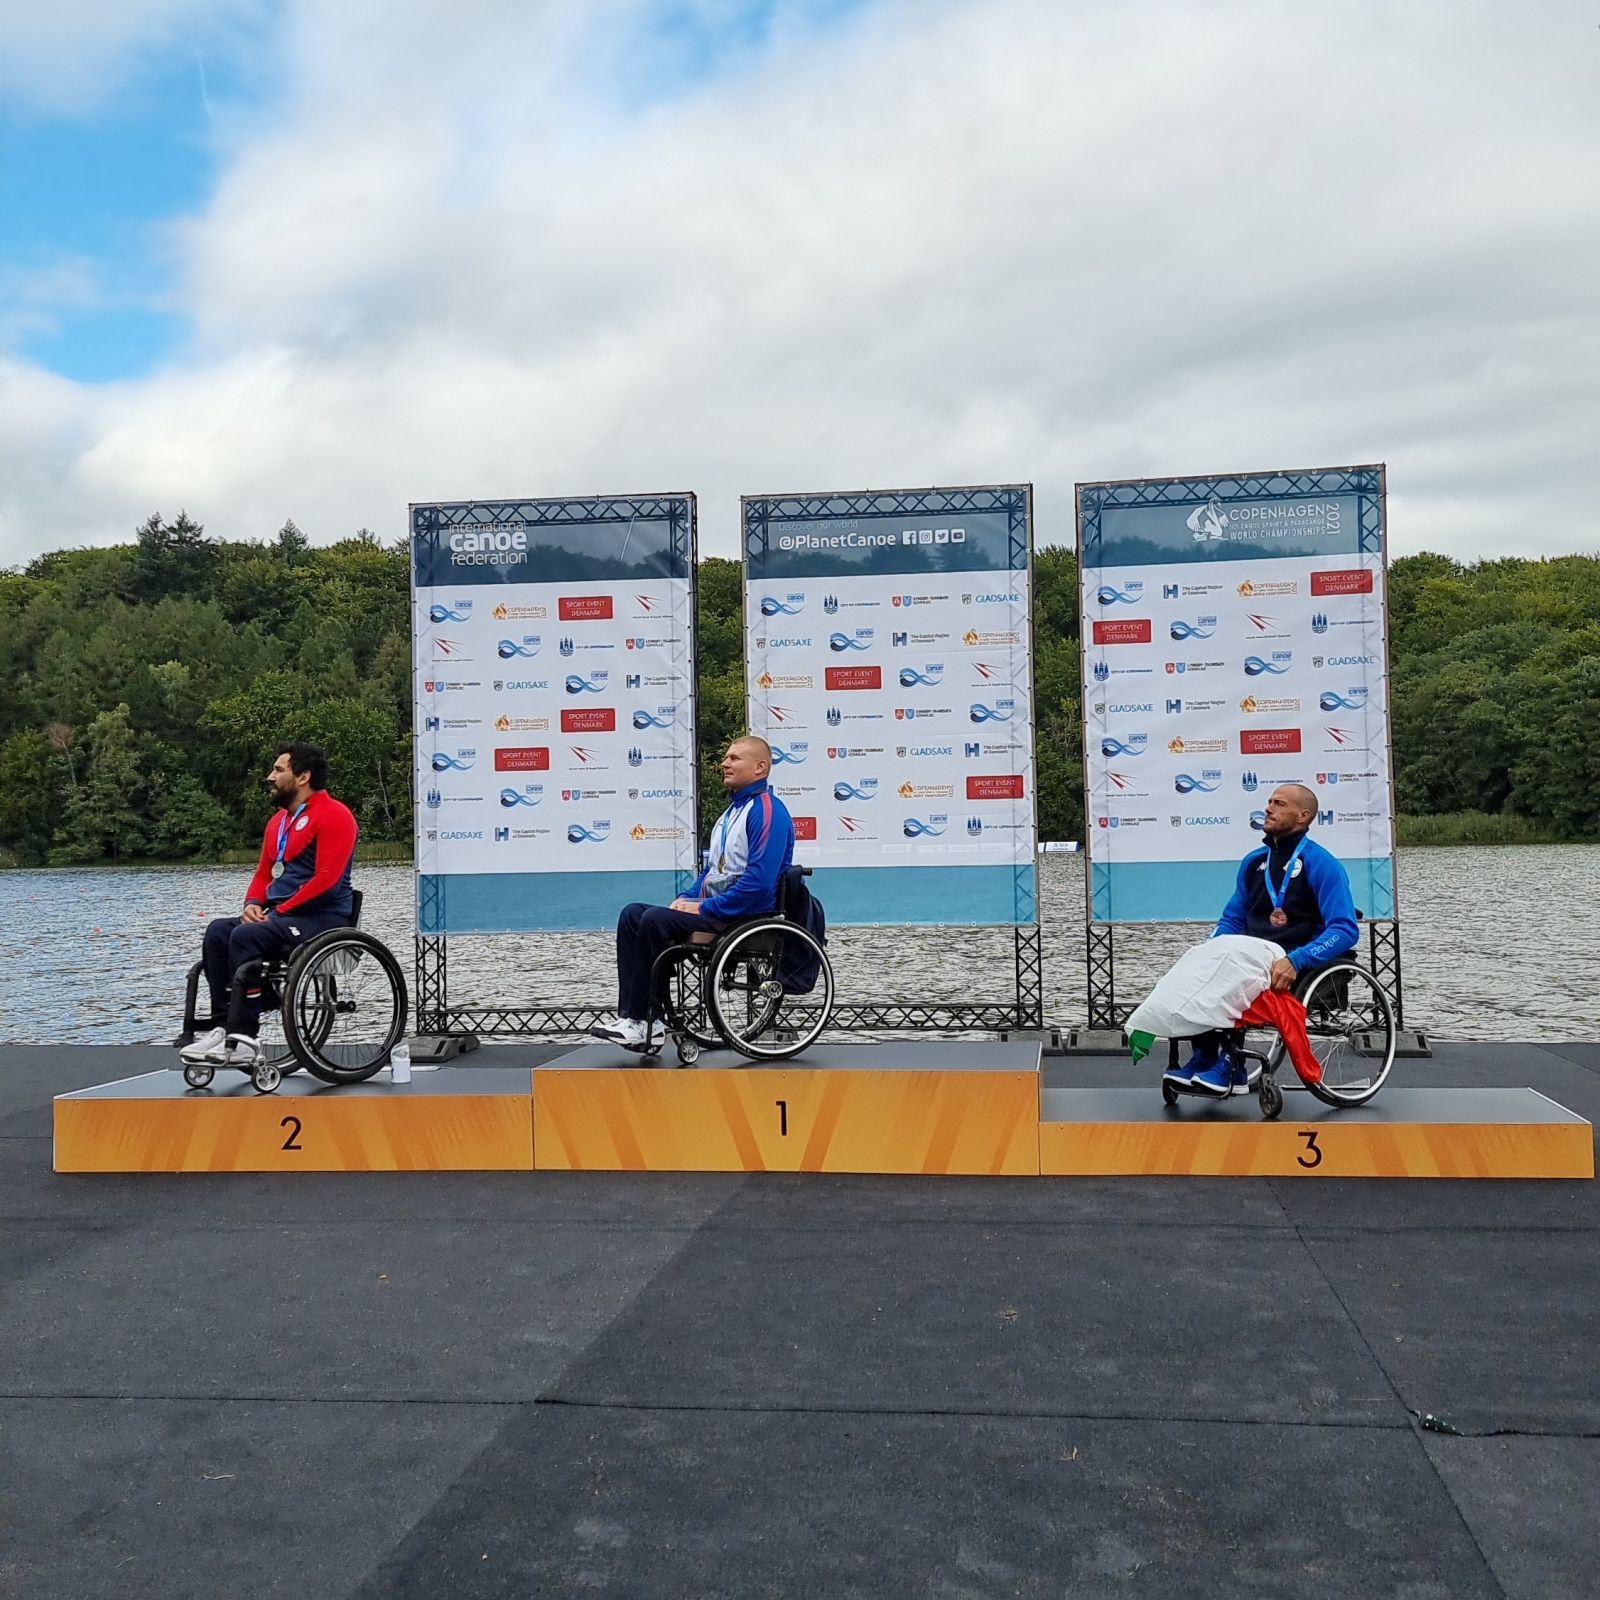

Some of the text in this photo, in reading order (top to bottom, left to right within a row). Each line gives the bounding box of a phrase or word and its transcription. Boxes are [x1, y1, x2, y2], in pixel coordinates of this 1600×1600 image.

[1230, 504, 1326, 521] COPENHAGEN
[1326, 502, 1340, 534] 2021
[449, 520, 527, 533] international
[778, 522, 814, 531] Discover
[833, 520, 858, 529] world
[1230, 527, 1326, 540] WORLD CHAMPIONSHIPS
[450, 532, 528, 552] canoe
[779, 533, 896, 550] @PlanetCanoe
[450, 552, 528, 566] federation
[1325, 584, 1360, 592] DENMARK
[975, 594, 1020, 604] GLADSAXE
[770, 638, 812, 648] GLADSAXE
[1328, 656, 1376, 666] GLADSAXE
[506, 680, 549, 690] GLADSAXE
[1108, 704, 1154, 713] GLADSAXE
[910, 747, 953, 756] GLADSAXE
[642, 790, 684, 798] GLADSAXE
[1184, 816, 1230, 826] GLADSAXE
[440, 831, 483, 840] GLADSAXE
[775, 1100, 788, 1136] 1
[280, 1116, 302, 1150] 2
[1296, 1131, 1323, 1168] 3
